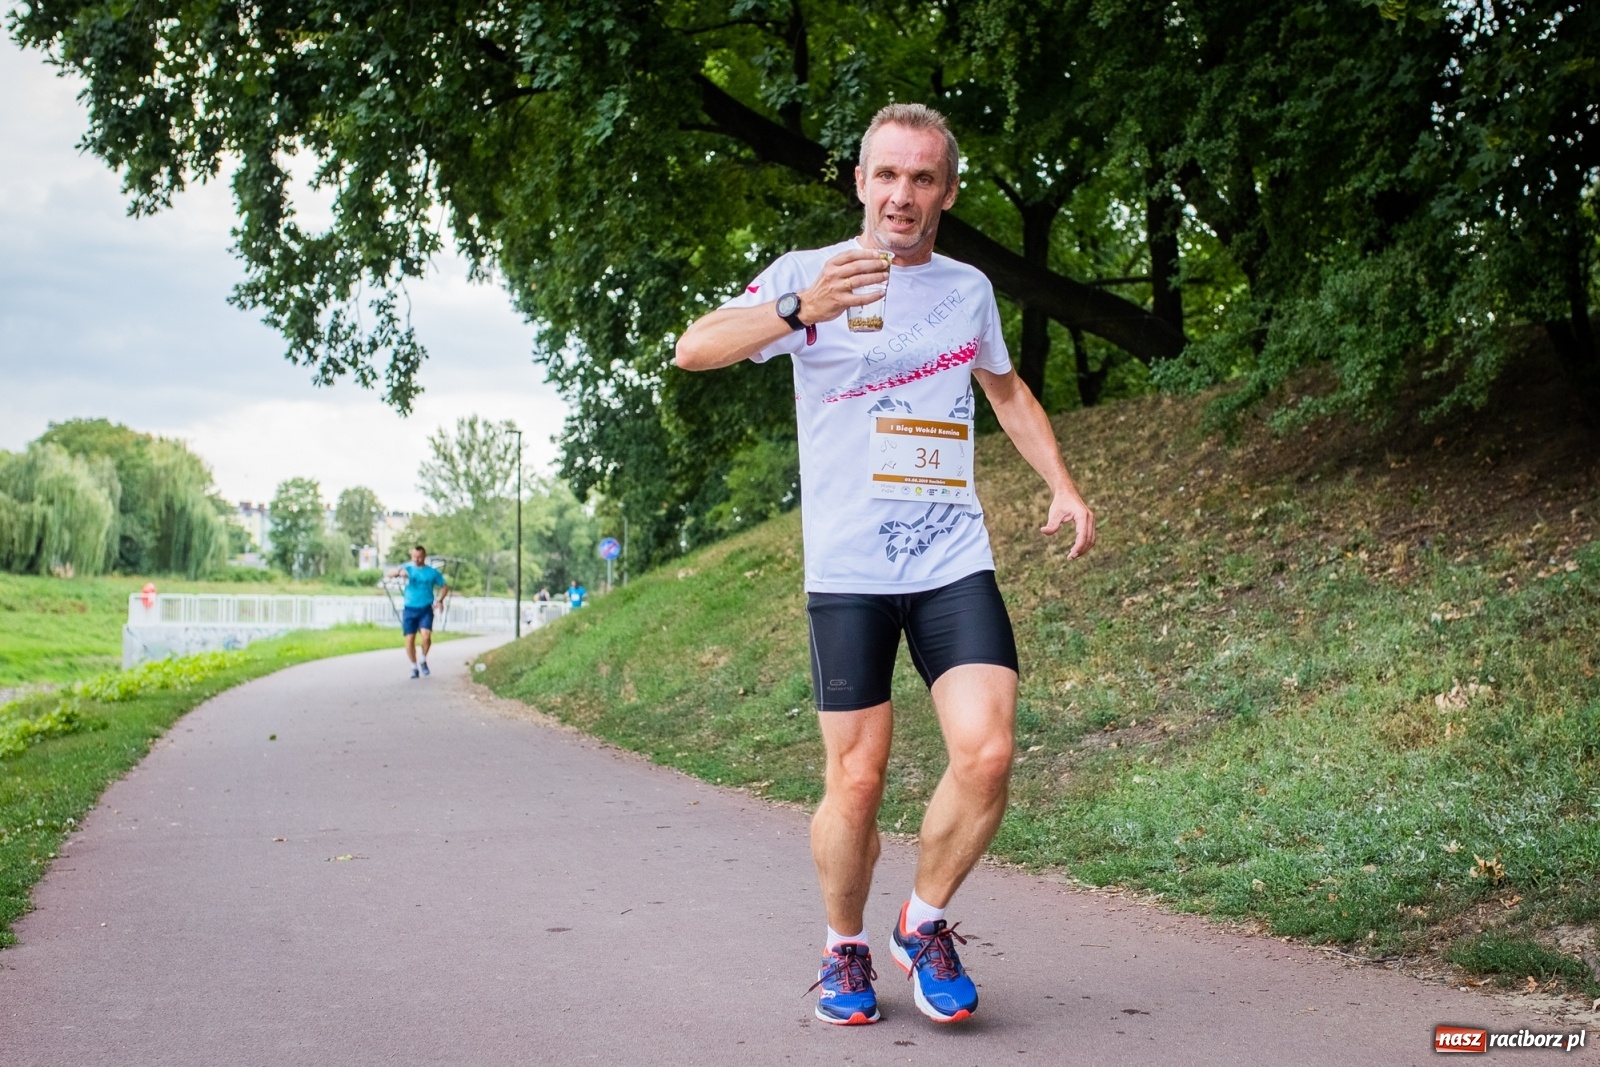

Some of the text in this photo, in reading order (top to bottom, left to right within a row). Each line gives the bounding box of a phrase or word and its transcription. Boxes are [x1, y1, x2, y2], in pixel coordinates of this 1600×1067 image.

[863, 288, 965, 366] KS GRYF KIETRZ
[896, 424, 913, 433] Bieg
[914, 447, 940, 470] 34
